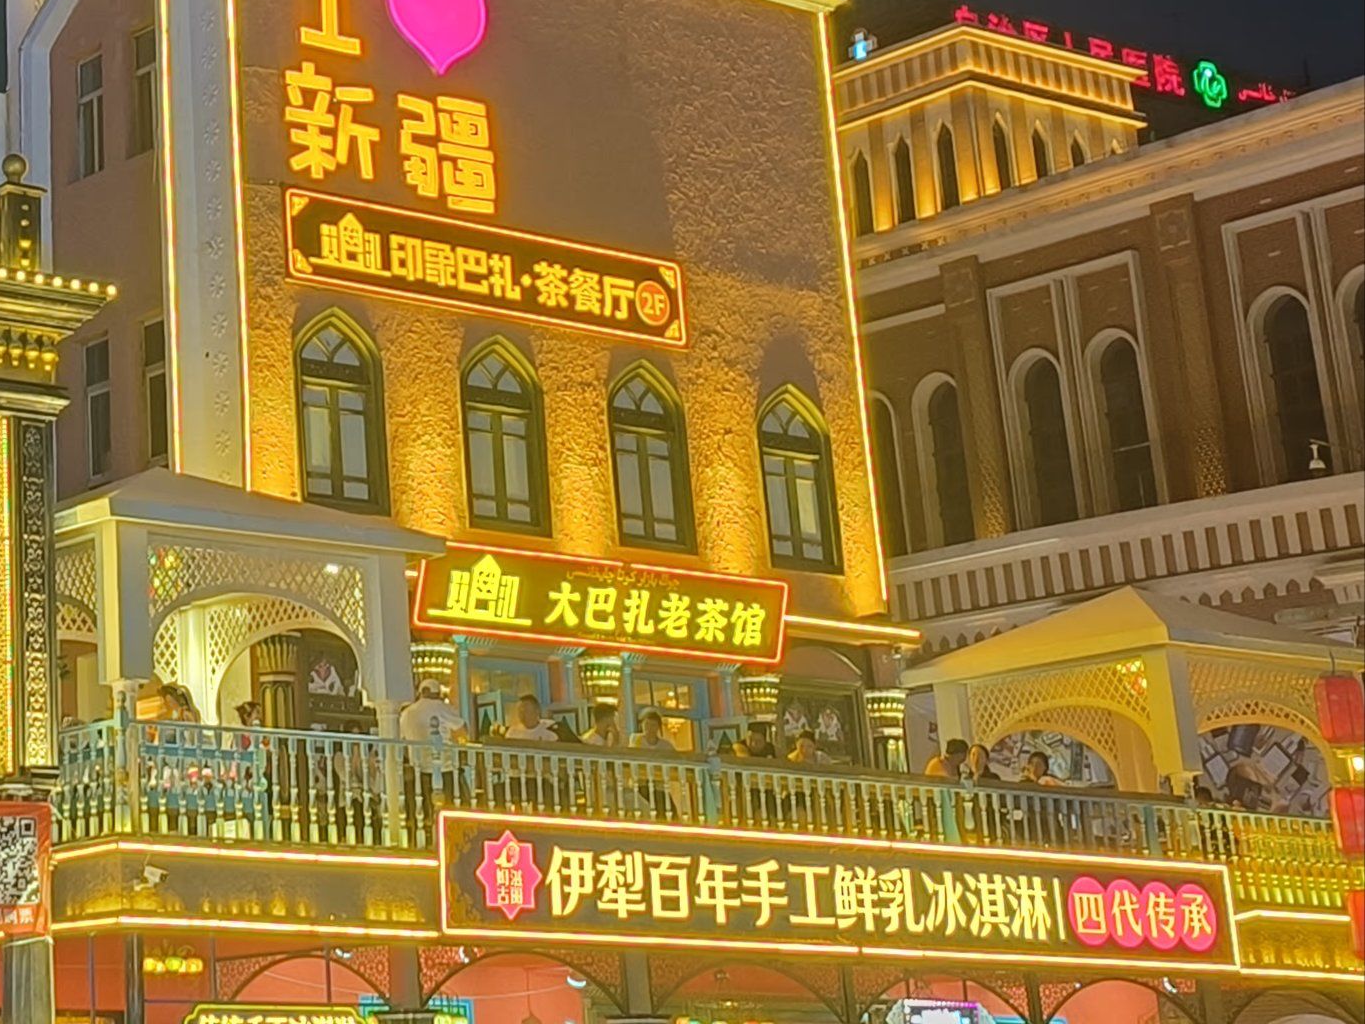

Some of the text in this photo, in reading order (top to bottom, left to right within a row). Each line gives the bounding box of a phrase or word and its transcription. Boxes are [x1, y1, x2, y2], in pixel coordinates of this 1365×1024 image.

[285, 62, 495, 214] 新疆
[641, 291, 666, 317] 2F
[544, 581, 767, 647] 大巴扎老茶馆
[545, 845, 1053, 942] 伊犁百年手工鲜乳冰淇淋
[1072, 891, 1213, 939] 四代传承
